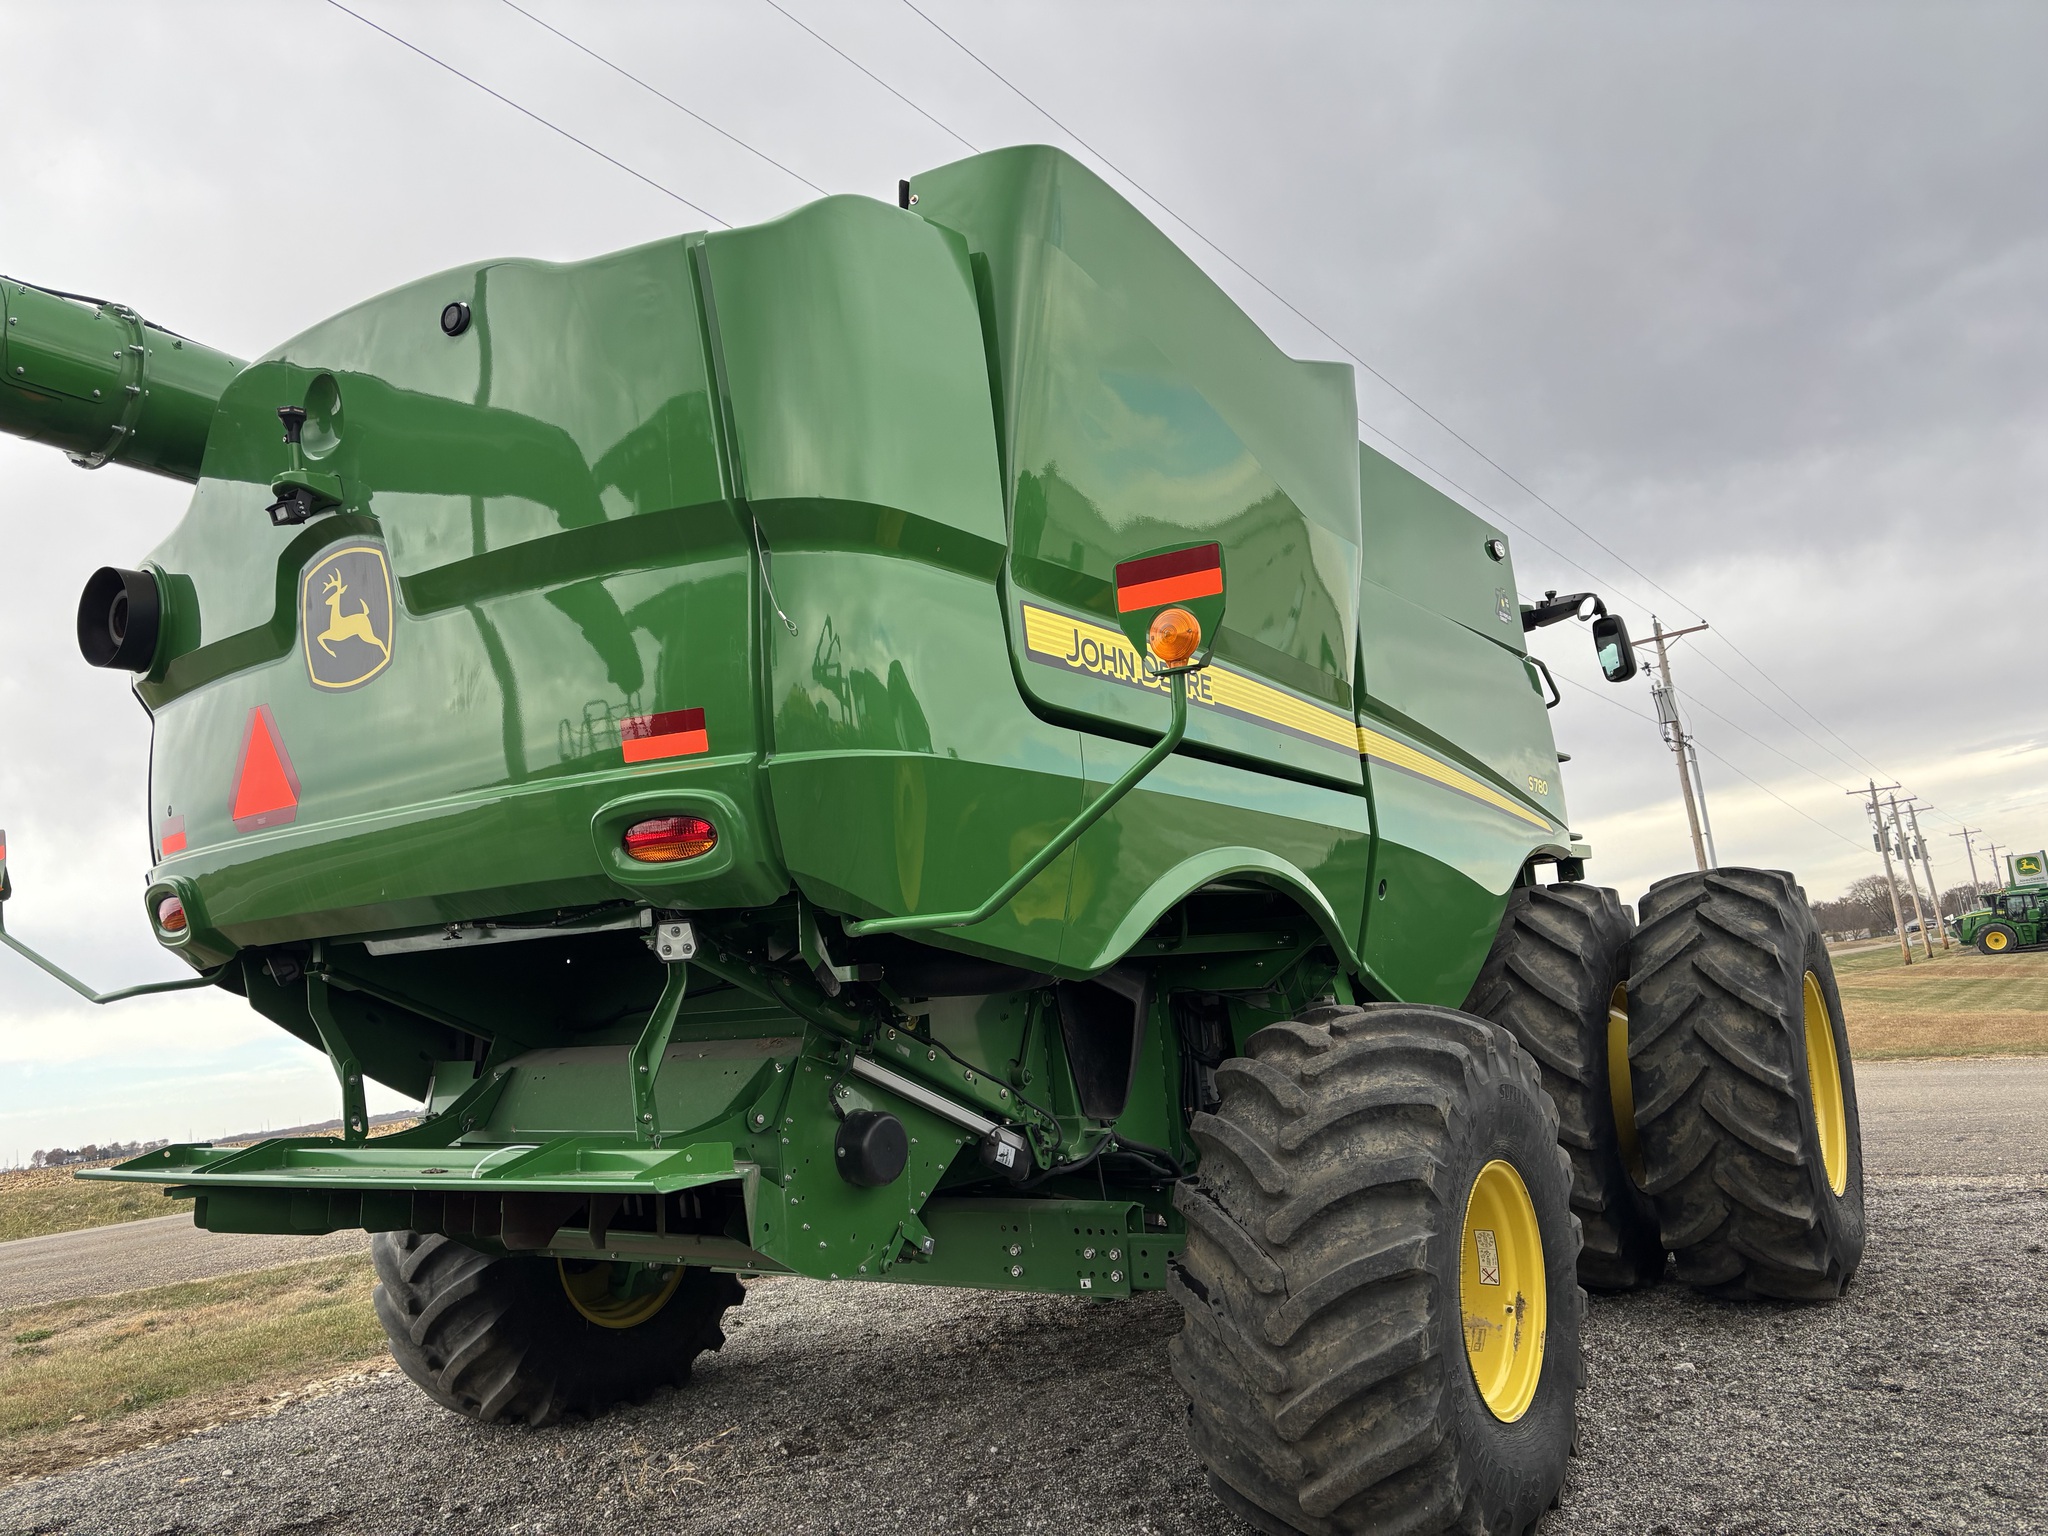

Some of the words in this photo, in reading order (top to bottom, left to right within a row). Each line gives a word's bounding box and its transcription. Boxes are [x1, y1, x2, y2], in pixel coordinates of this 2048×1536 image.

[1066, 628, 1136, 679] JOHN
[1141, 651, 1213, 701] DERE
[1528, 775, 1549, 796] S780
